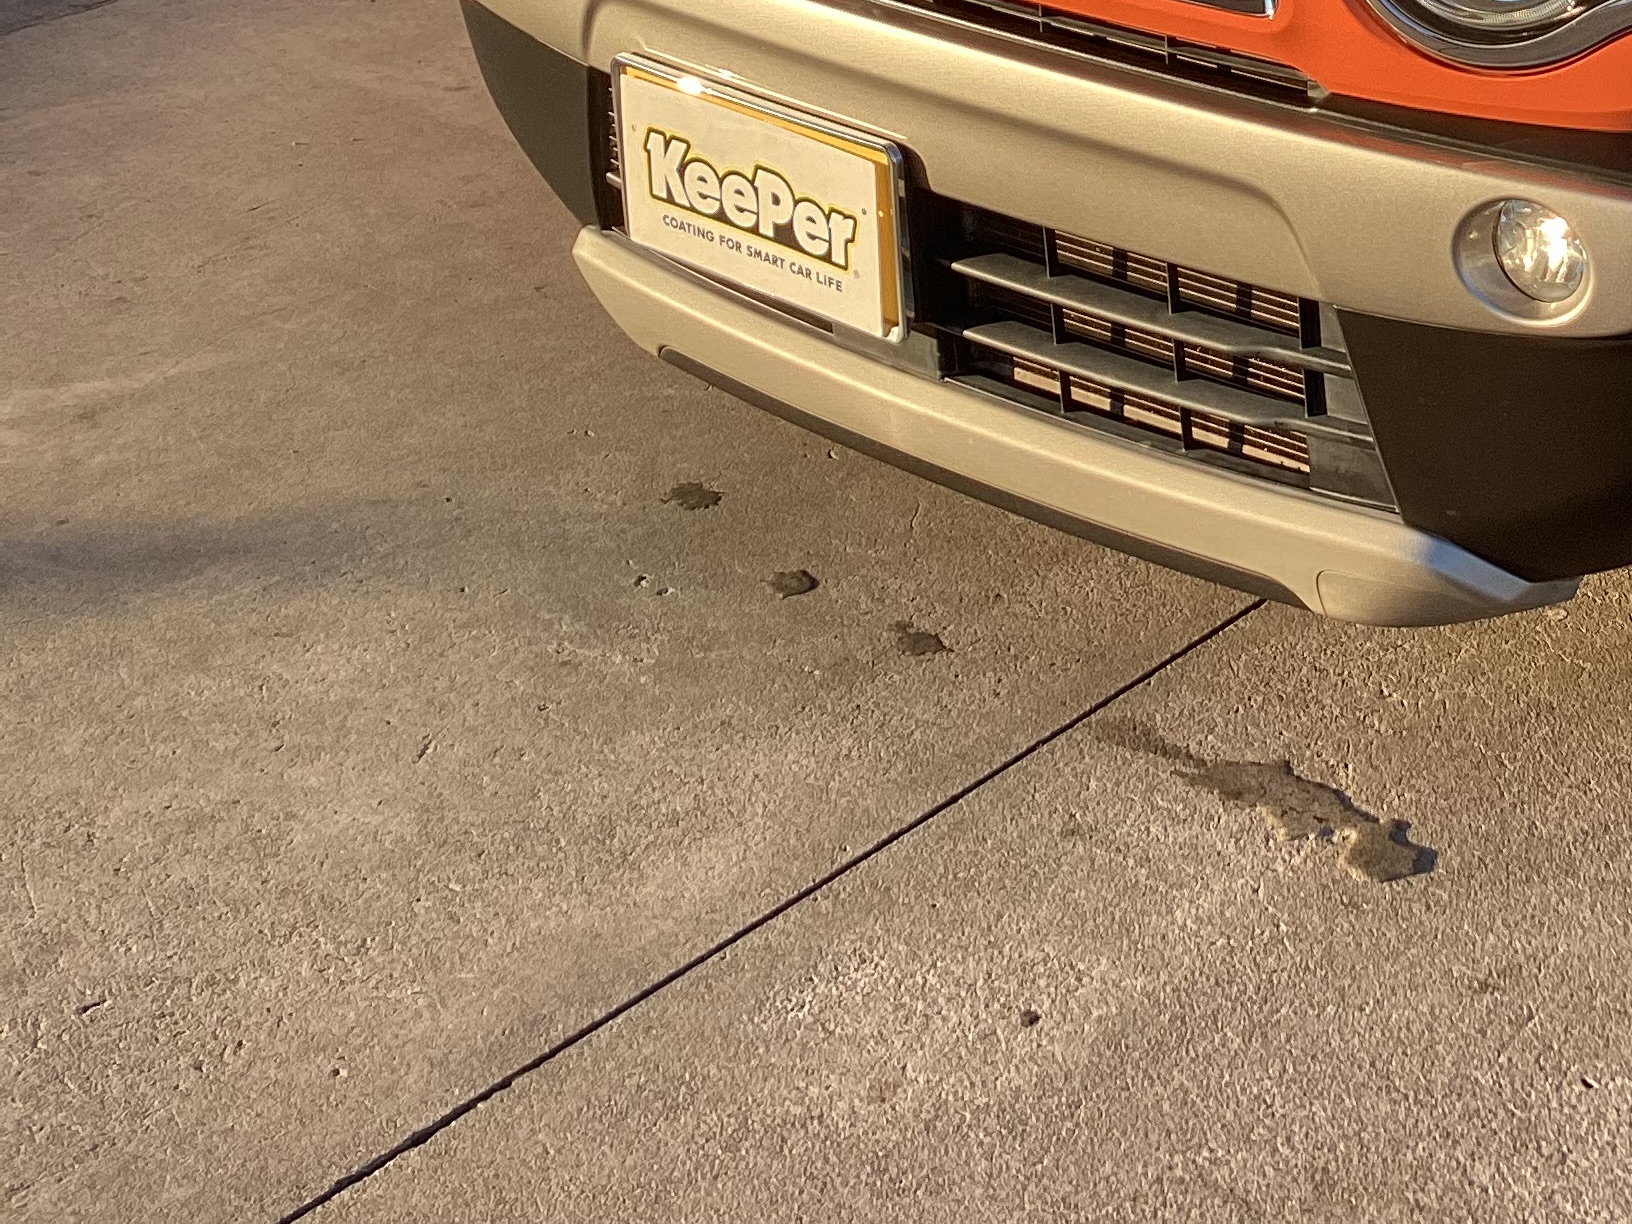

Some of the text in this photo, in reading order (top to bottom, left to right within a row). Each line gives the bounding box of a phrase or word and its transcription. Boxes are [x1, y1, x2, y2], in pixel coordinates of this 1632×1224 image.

[643, 127, 857, 271] KeePer
[662, 214, 843, 293] COATING FOR SMART CAR LIFE
